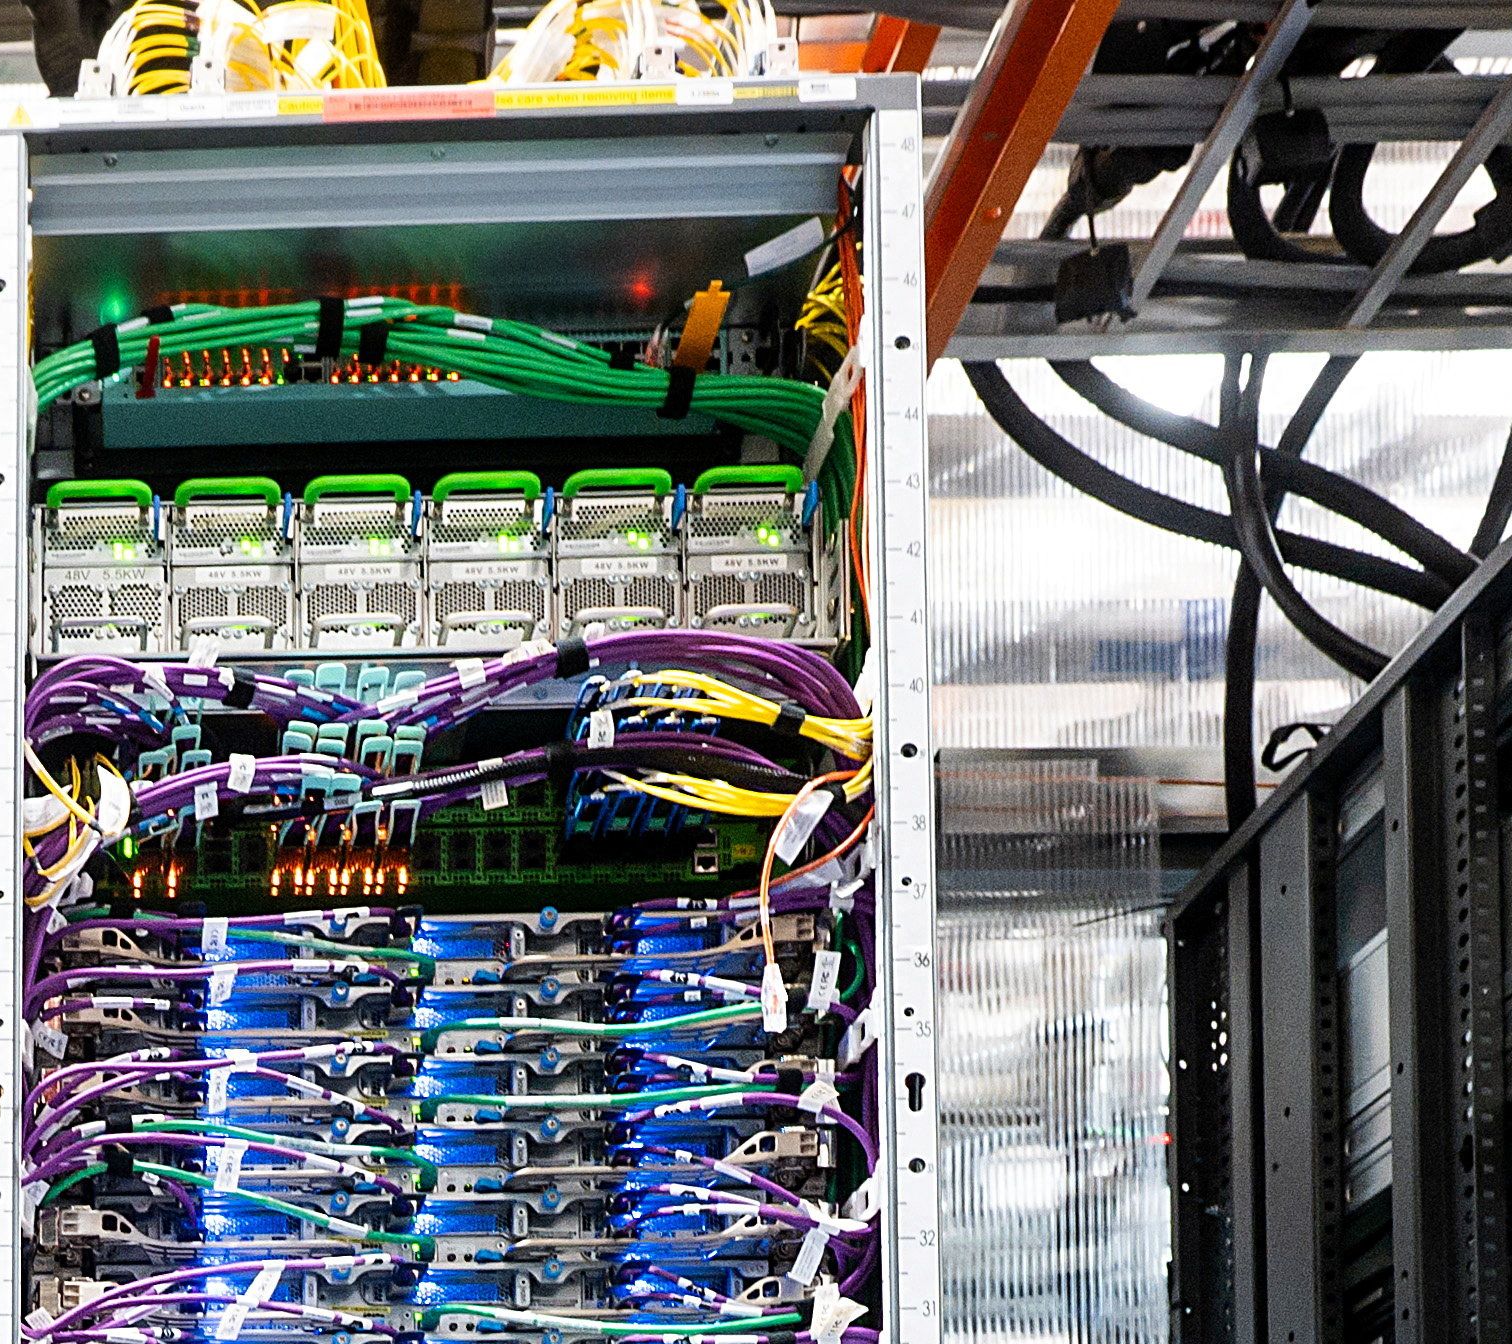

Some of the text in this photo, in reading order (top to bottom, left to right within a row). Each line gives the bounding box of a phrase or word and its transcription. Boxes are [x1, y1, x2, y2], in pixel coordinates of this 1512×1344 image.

[517, 95, 543, 105] care
[547, 92, 578, 103] when
[583, 90, 636, 105] removing
[640, 89, 673, 100] items
[594, 562, 612, 570] 48V
[725, 559, 743, 567] 48V
[65, 570, 90, 580] 48V
[208, 570, 226, 578] 48V
[337, 567, 355, 576] 48V
[465, 566, 483, 575] 48V
[911, 609, 922, 624] 41
[916, 952, 930, 968] 36
[917, 1021, 931, 1036] 35
[920, 1231, 934, 1247] 32
[923, 1301, 935, 1316] 31
